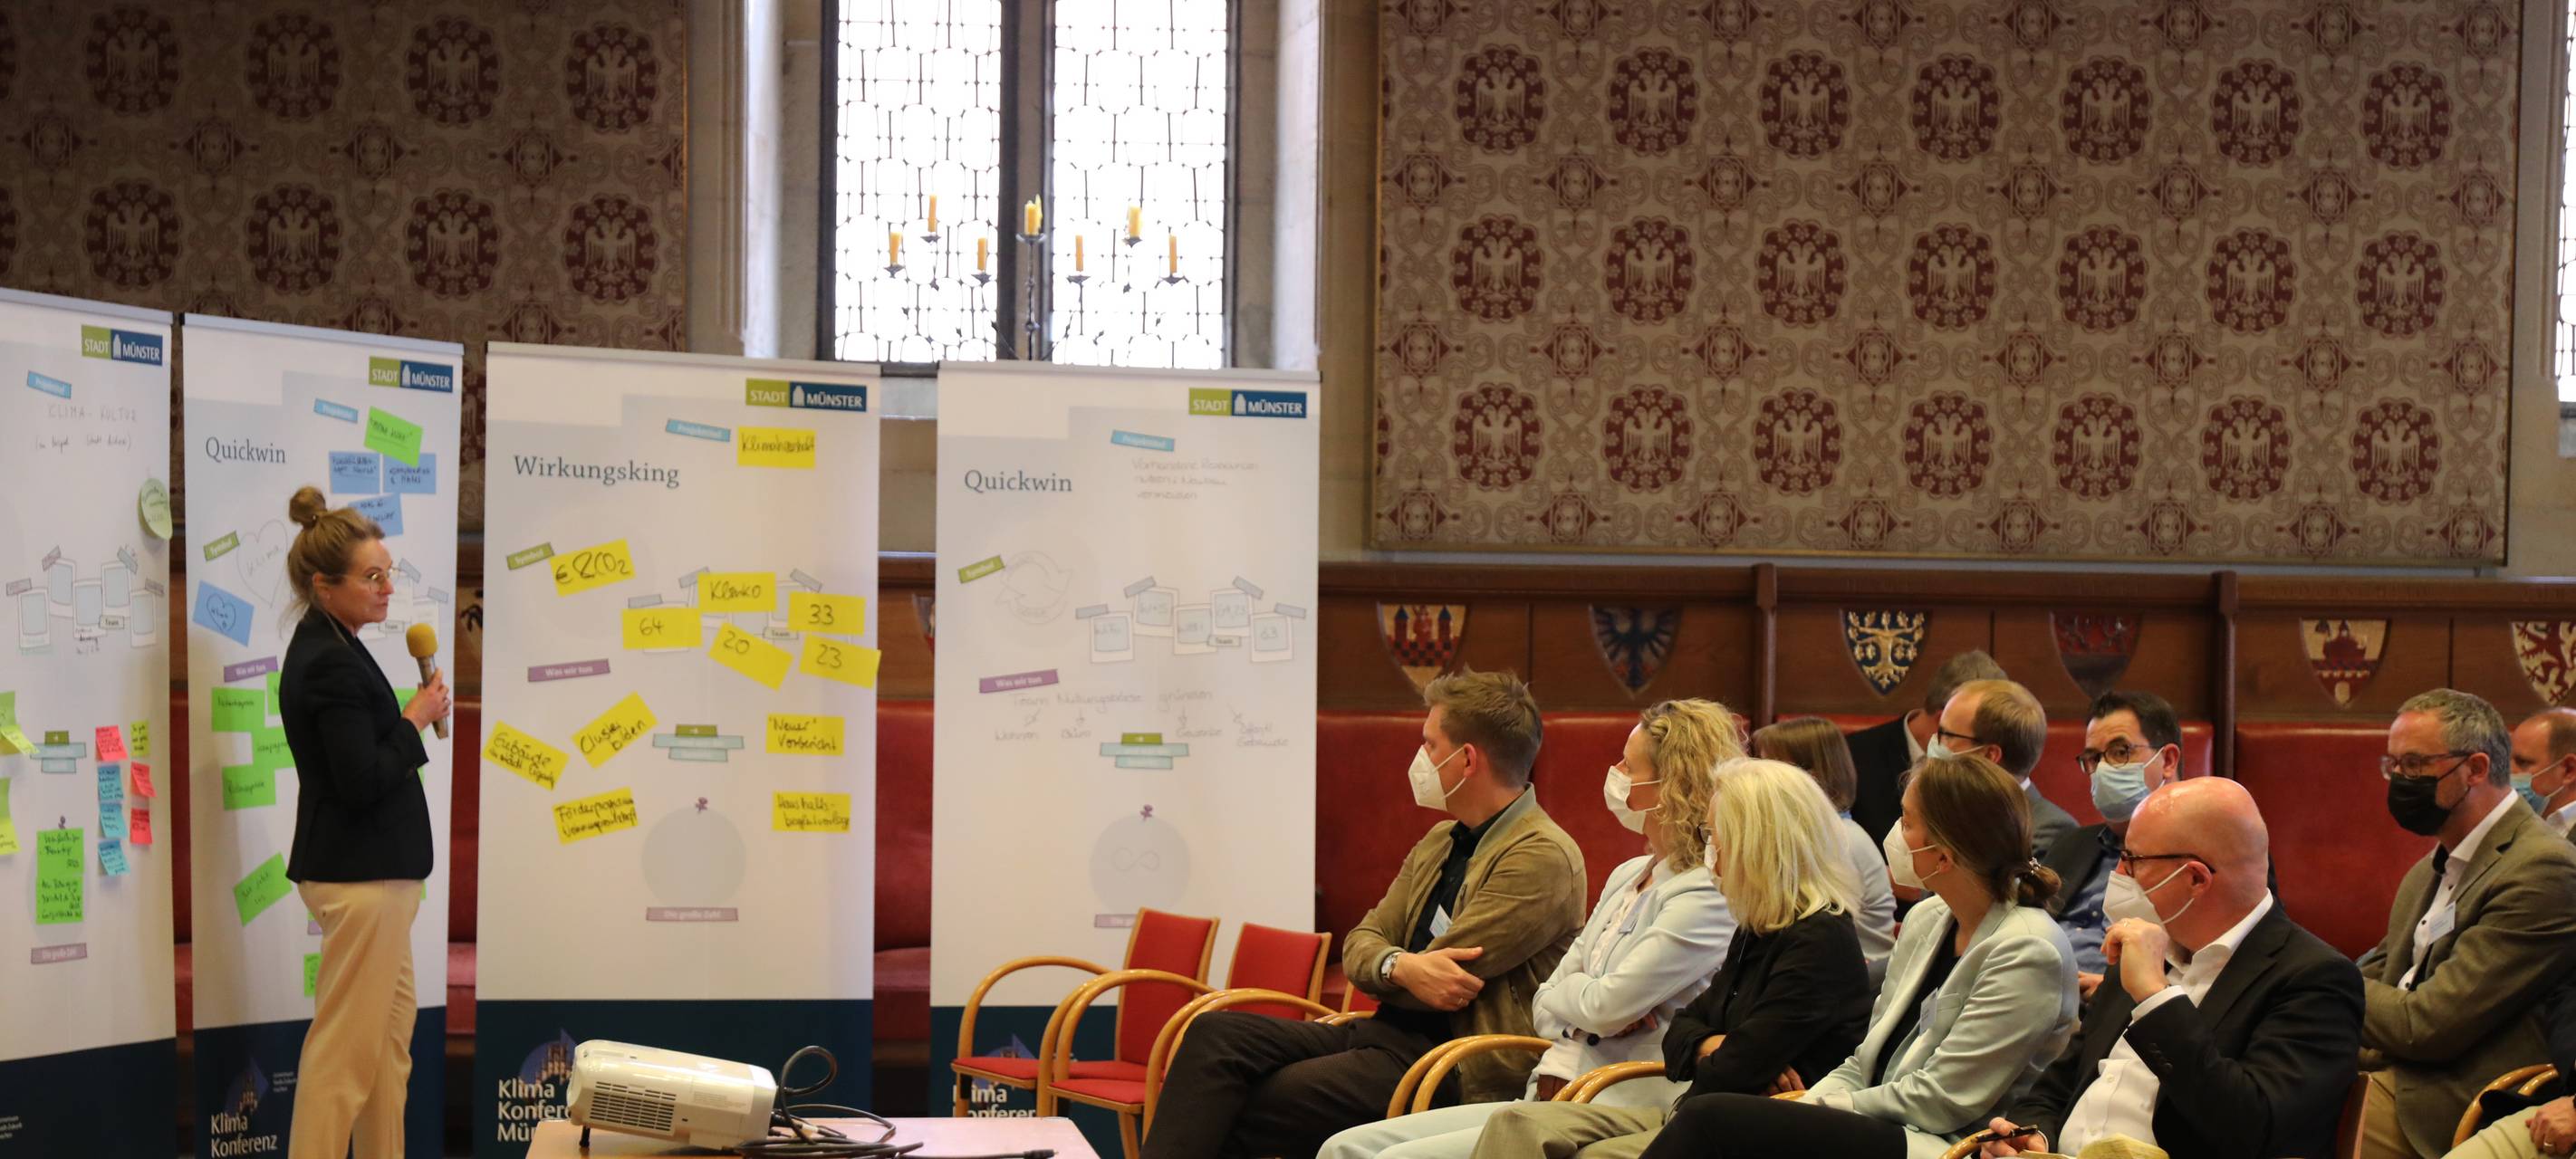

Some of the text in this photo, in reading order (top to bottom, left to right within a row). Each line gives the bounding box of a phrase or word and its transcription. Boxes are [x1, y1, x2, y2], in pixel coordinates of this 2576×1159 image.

[84, 339, 160, 360] STADT MÜNSTER
[372, 368, 450, 388] STADT MÜNSTER
[750, 389, 862, 407] STADT MÜNSTER
[1193, 399, 1302, 414] STADT MÜNSTER
[206, 436, 286, 465] Quickwin
[514, 455, 680, 489] Wirkungsking
[964, 469, 1072, 494] Quickwin
[807, 603, 835, 627] 33
[639, 617, 665, 637] 64
[722, 629, 750, 655] 20
[816, 643, 843, 670] 23
[498, 1077, 555, 1099] Klima
[211, 1112, 248, 1135] Klima
[211, 1133, 278, 1159] Konferenz
